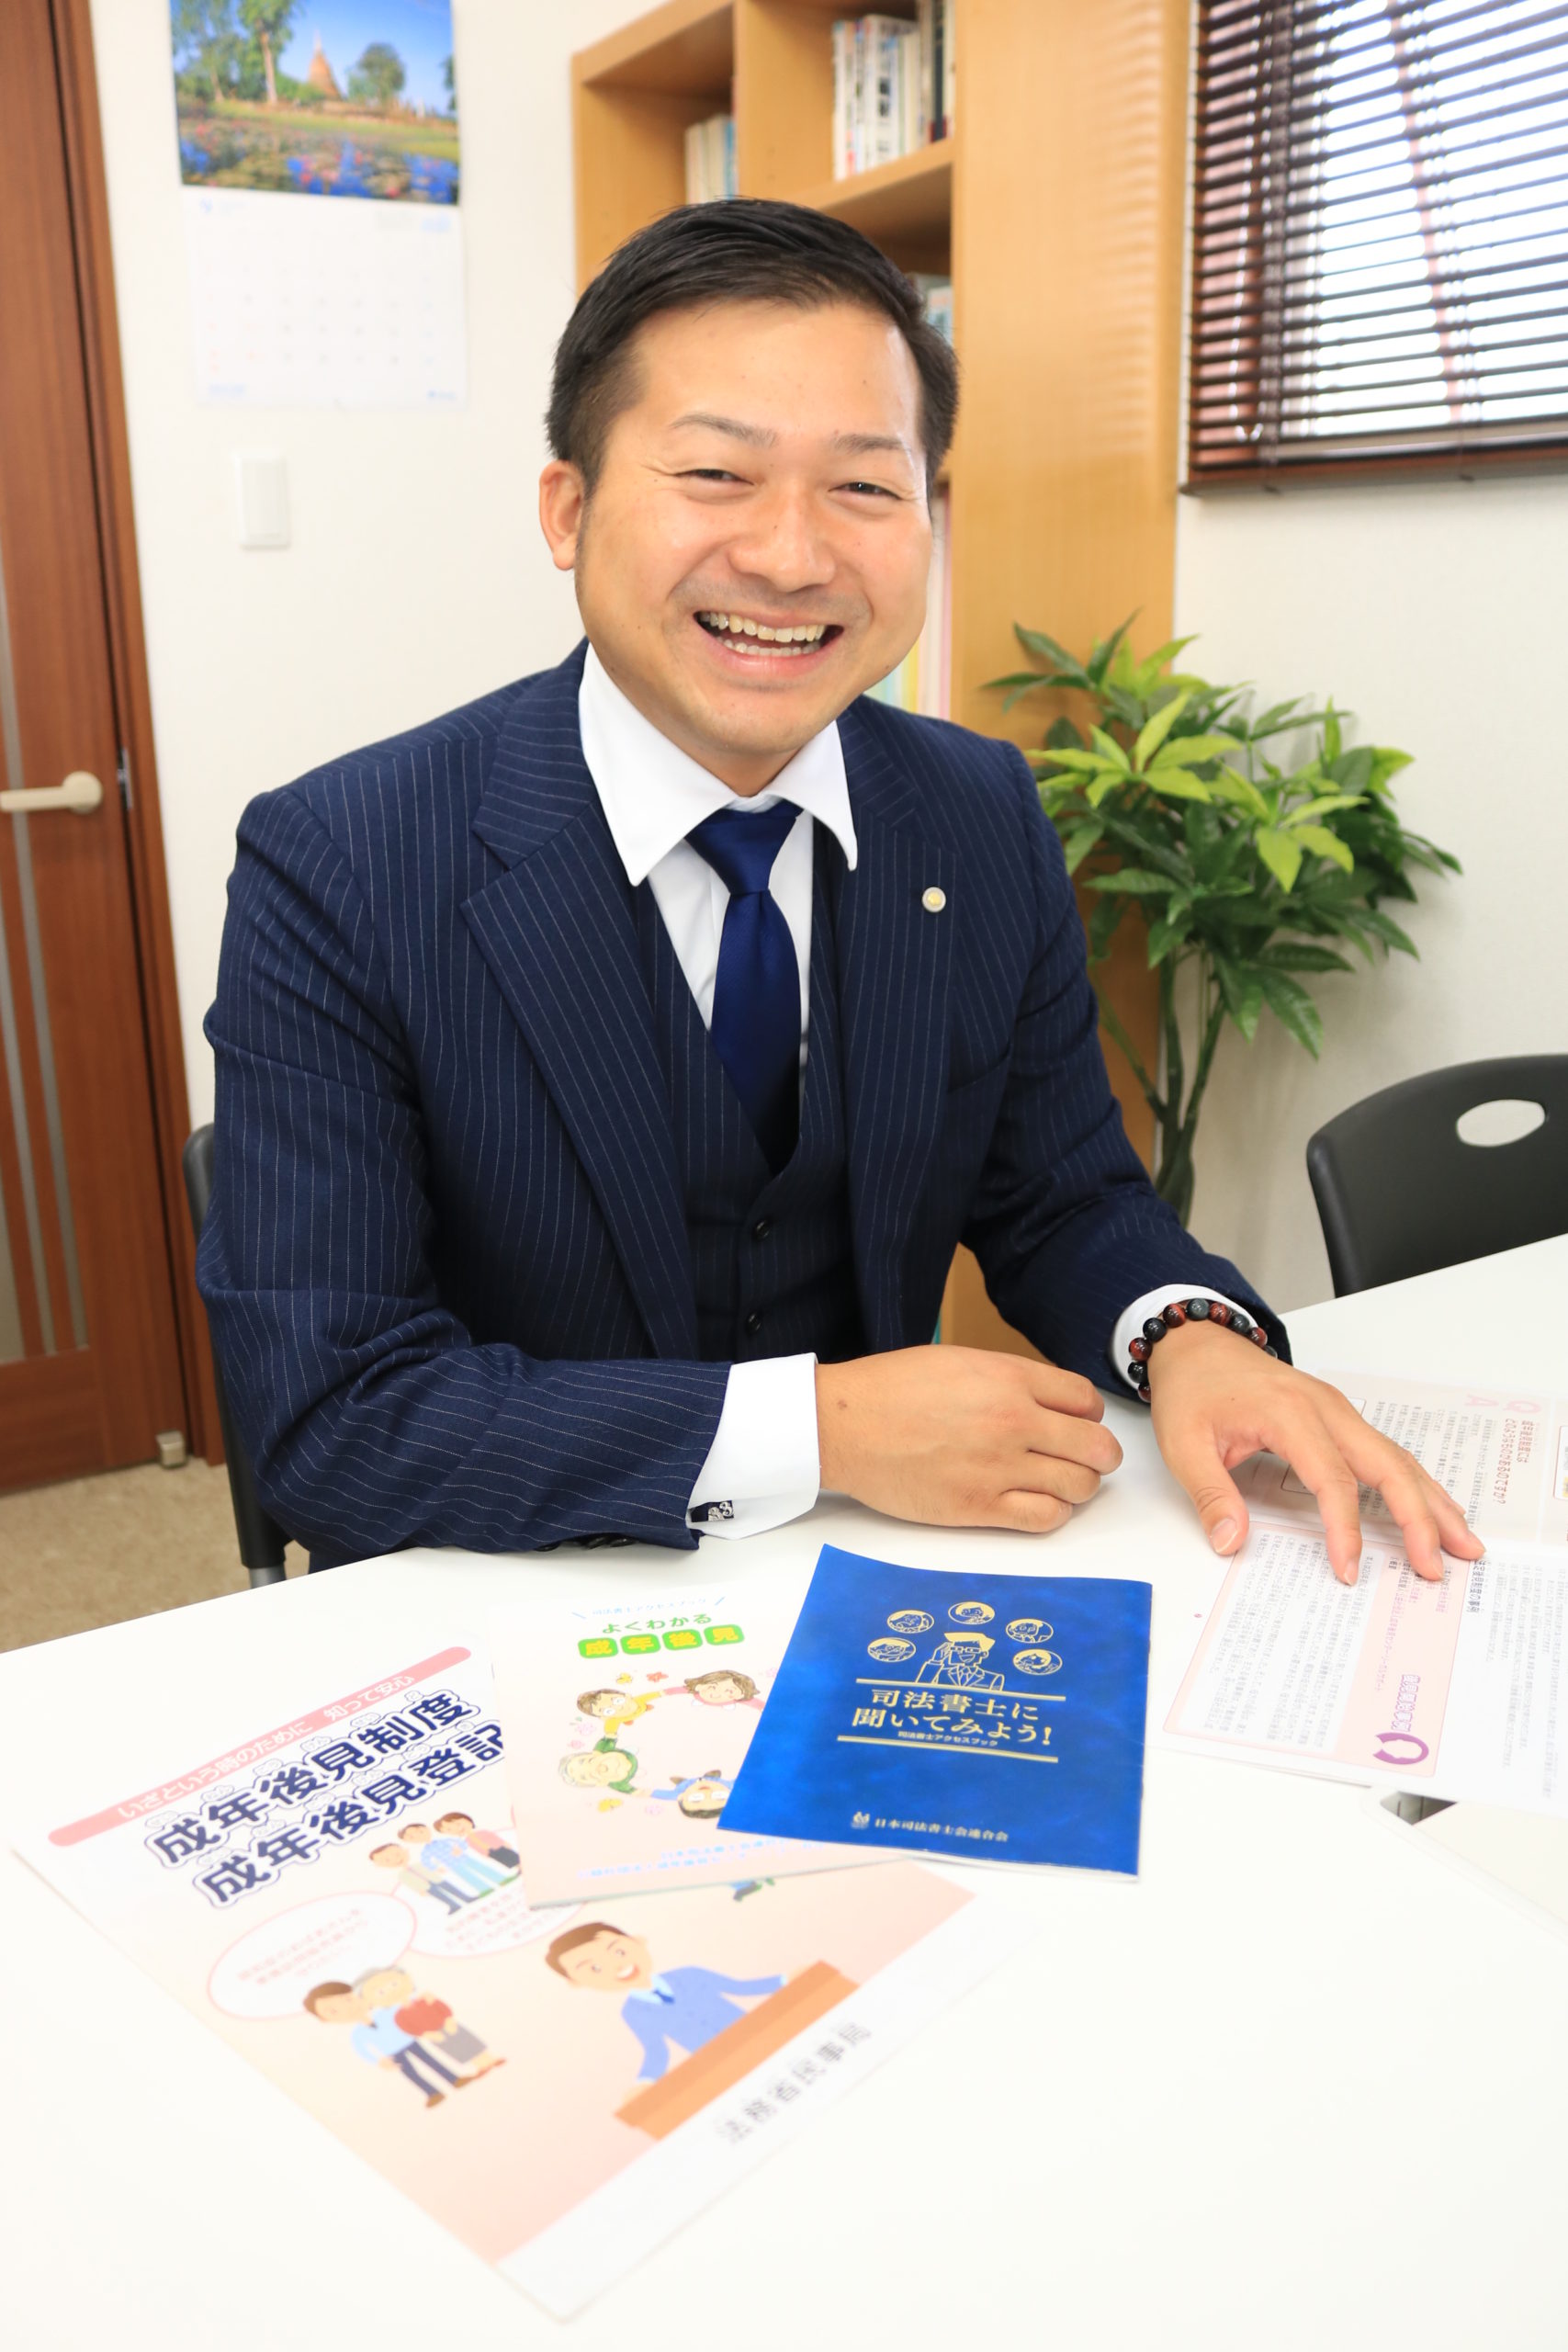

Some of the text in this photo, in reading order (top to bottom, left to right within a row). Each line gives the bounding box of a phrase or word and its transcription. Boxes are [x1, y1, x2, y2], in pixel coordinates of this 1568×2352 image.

[602, 1613, 713, 1634] よくわかる
[585, 1625, 740, 1657] 成年後見
[871, 1689, 1039, 1721] 司法書士に
[153, 1693, 474, 1864] 成年後見制度
